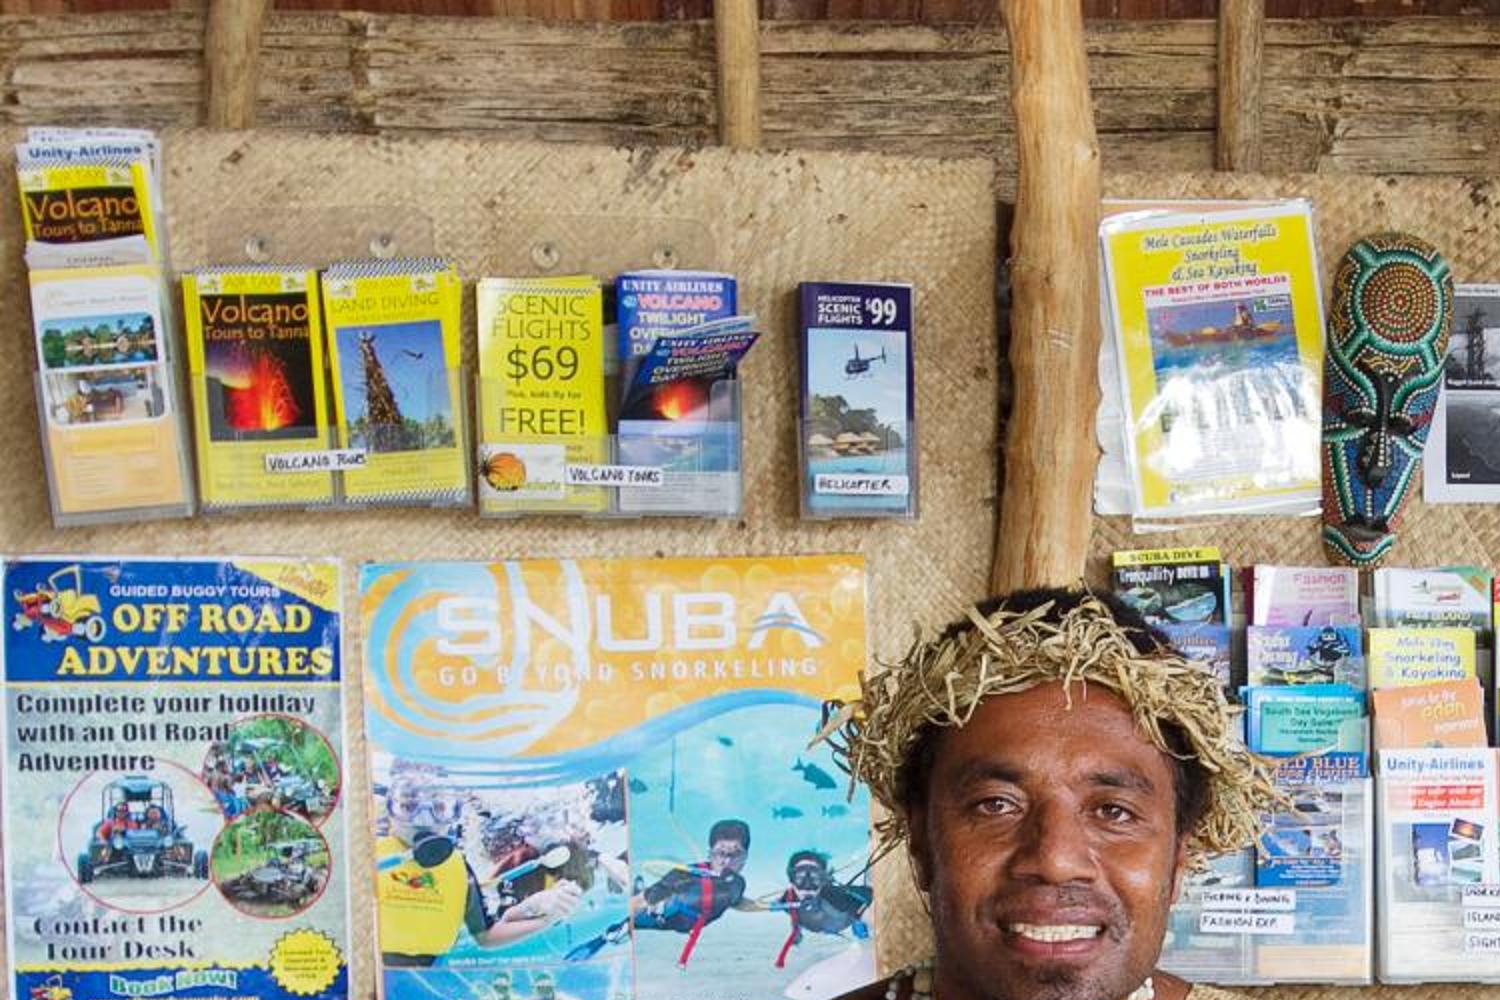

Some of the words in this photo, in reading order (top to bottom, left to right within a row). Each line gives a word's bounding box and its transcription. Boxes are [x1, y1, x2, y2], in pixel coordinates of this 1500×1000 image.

[29, 144, 142, 160] Unity-Airlines
[27, 189, 141, 222] Volcano
[622, 279, 661, 291] UNITY
[664, 280, 724, 293] AIRLINES
[1144, 288, 1165, 297] THE
[1167, 285, 1194, 295] BEST
[1245, 276, 1288, 287] WORLDS
[202, 295, 309, 326] Volcano
[331, 296, 379, 313] LAND
[381, 291, 440, 311] DIVING
[493, 296, 586, 318] SCENIC
[638, 293, 723, 311] VOLCANO
[817, 302, 862, 315] SCENIC
[866, 297, 898, 327] $99
[637, 311, 706, 324] TWILIGHT
[817, 312, 863, 326] FLIGHTS
[206, 326, 246, 340] Tours
[491, 319, 592, 341] FLIGHTS
[506, 344, 580, 385] $69
[500, 407, 585, 436] FREE!
[268, 455, 331, 470] VOLCANO
[569, 469, 625, 482] VOLCANO
[628, 469, 660, 483] TOURS
[1130, 552, 1171, 561] SCUBA
[1172, 550, 1202, 560] DIVE
[109, 586, 168, 598] GUIDED
[171, 586, 225, 598] BUGGY
[229, 586, 281, 598] TOURS
[112, 603, 193, 633] OFF
[199, 603, 312, 633] ROAD
[434, 590, 828, 658] SNUBA
[56, 645, 334, 676] ADVENTURES
[438, 668, 478, 687] GO
[631, 656, 819, 681] SNORKELING
[17, 693, 146, 716] Complete
[153, 696, 213, 715] your
[218, 693, 315, 714] holiday
[17, 723, 75, 742] with
[82, 726, 114, 741] an
[164, 722, 230, 742] Road
[17, 752, 156, 772] Adventure
[1312, 757, 1361, 769] BLUE
[1386, 757, 1486, 772] Unity-Airlines
[33, 915, 145, 936] Contact
[159, 913, 203, 934] the
[124, 940, 196, 960] Desk
[110, 974, 174, 997] Book
[175, 970, 238, 991] NOW!
